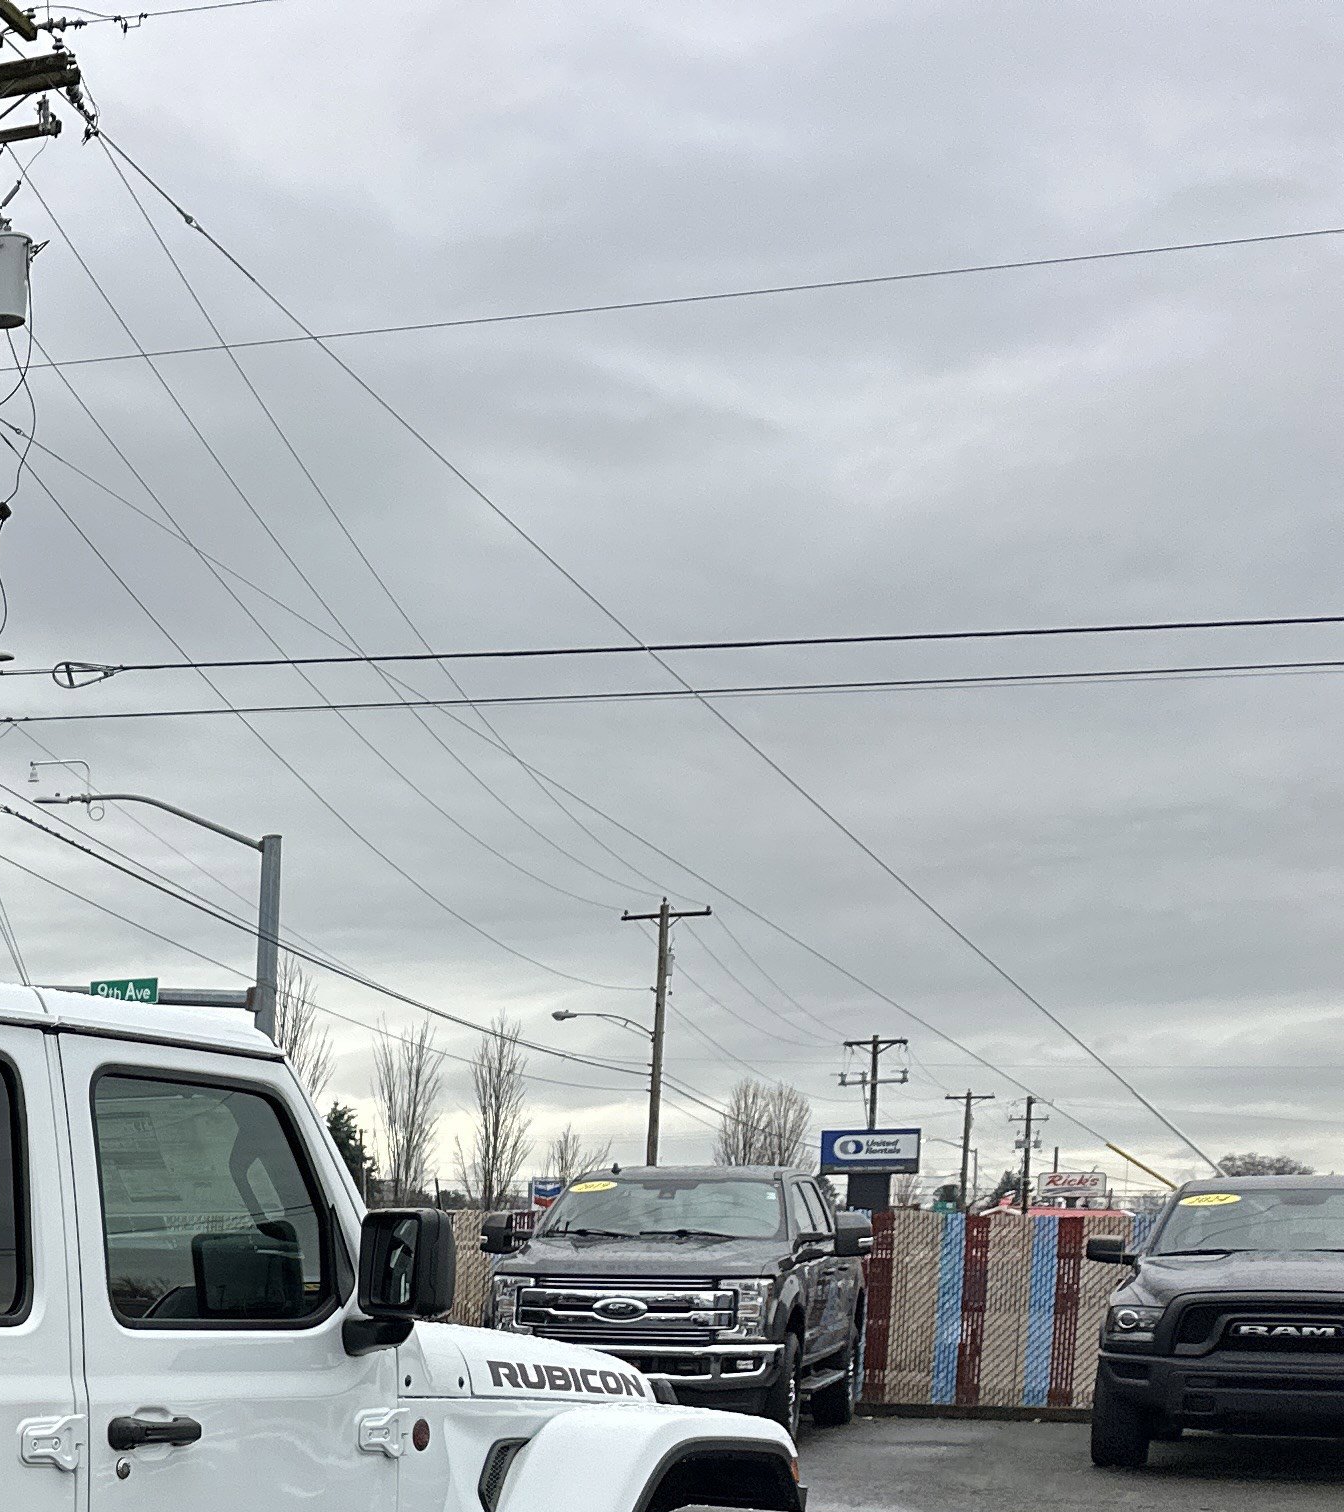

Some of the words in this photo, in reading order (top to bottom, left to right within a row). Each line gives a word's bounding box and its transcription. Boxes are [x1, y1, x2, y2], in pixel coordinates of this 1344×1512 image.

[97, 983, 122, 1000] 9th
[125, 981, 151, 1000] Ave
[865, 1138, 900, 1147] United
[865, 1147, 901, 1155] Rentals
[1045, 1174, 1099, 1187] Rick's
[1239, 1325, 1336, 1336] RAM
[486, 1360, 646, 1398] RUBICON
